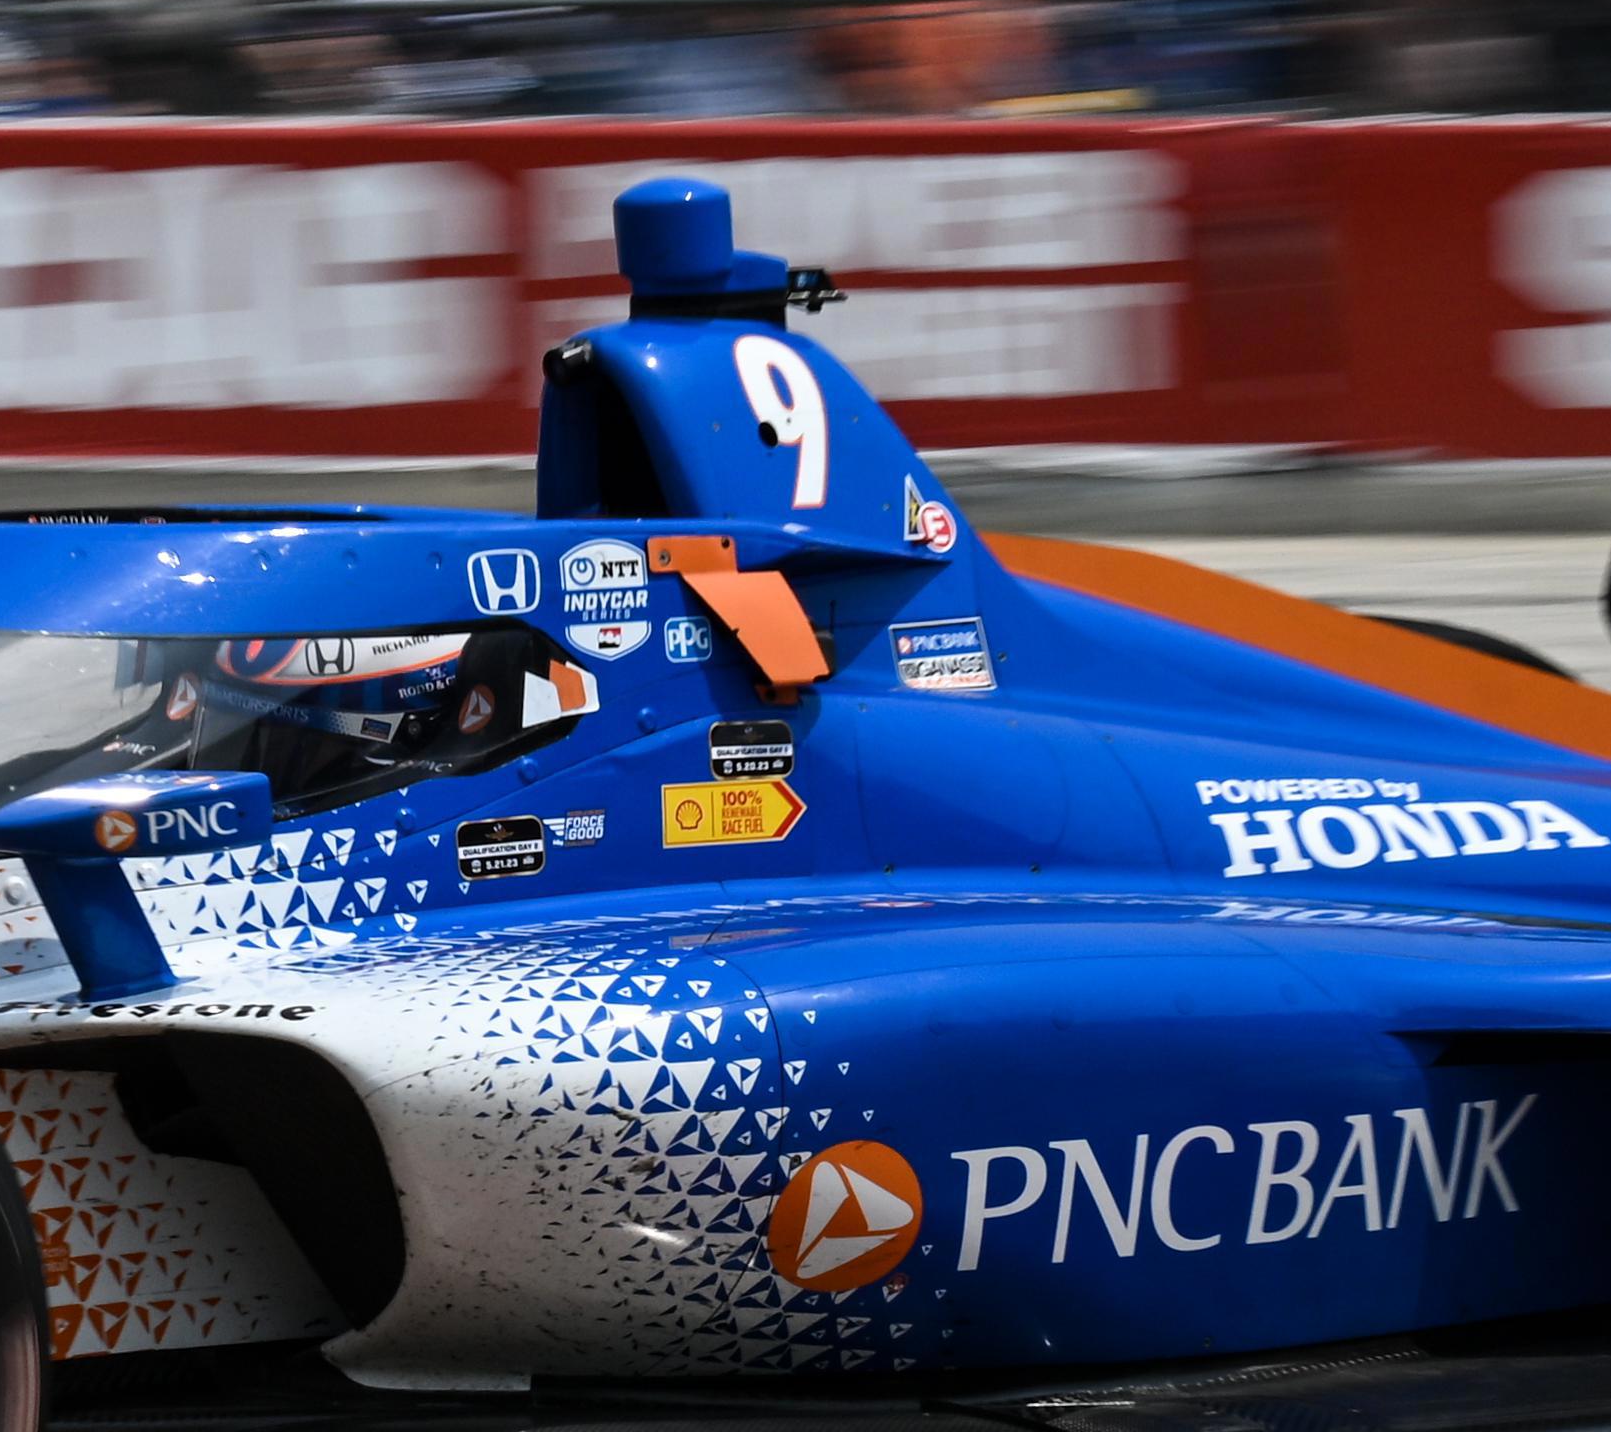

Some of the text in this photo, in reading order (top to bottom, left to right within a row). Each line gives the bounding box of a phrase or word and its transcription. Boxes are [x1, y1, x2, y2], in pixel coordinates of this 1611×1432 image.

[732, 334, 829, 509] 9
[600, 559, 639, 579] NTT
[563, 589, 648, 613] INDYCAR
[667, 622, 709, 657] PPG
[721, 790, 763, 807] 100%
[1195, 777, 1421, 805] POWERED by
[142, 801, 239, 844] PNC
[566, 814, 605, 828] FORCE
[721, 818, 764, 835] RACE FUEL
[568, 826, 604, 840] GOOD
[1209, 799, 1611, 878] HONDA
[462, 845, 517, 857] QUALIFICATION
